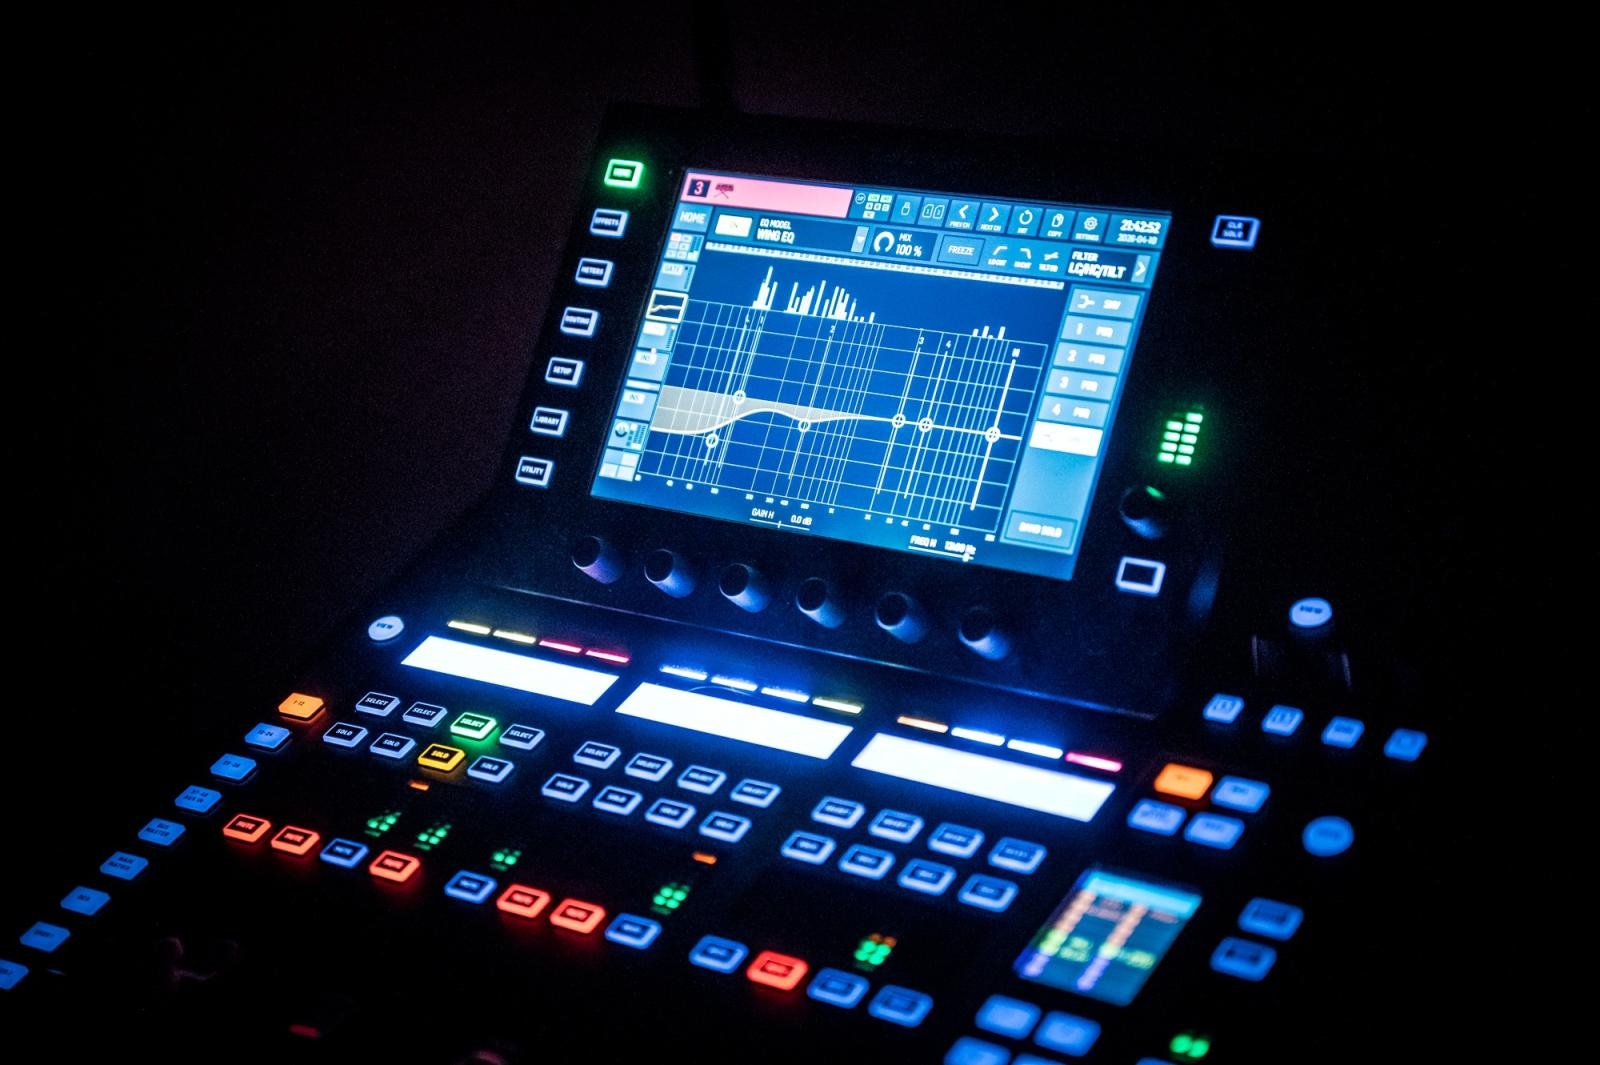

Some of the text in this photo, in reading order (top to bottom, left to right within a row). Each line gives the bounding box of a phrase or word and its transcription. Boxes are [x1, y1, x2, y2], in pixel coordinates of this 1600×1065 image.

[693, 181, 704, 196] 3
[680, 211, 707, 225] HOME
[760, 217, 792, 231] EQ MODEL
[756, 228, 795, 245] WING EQ
[898, 233, 913, 242] MIX
[895, 243, 922, 257] 100 %
[948, 245, 976, 256] FREEZE
[1071, 250, 1099, 262] FILTER
[1066, 349, 1077, 362] 2
[552, 365, 573, 375] SETUP
[1059, 376, 1069, 389] 3
[535, 415, 560, 426] LIBRARY
[521, 465, 544, 476] UTILITY
[751, 507, 769, 519] GAIN
[790, 514, 813, 526] 0.0 dB
[376, 622, 395, 630] VIEW
[364, 697, 389, 707] SELECT
[412, 706, 436, 717] SELECT
[459, 718, 485, 728] SELECT
[335, 727, 353, 737] SOLO
[509, 729, 533, 740] SELECT
[383, 738, 401, 748] SOLO
[430, 749, 450, 760] SOLO
[584, 747, 609, 758] SELECT
